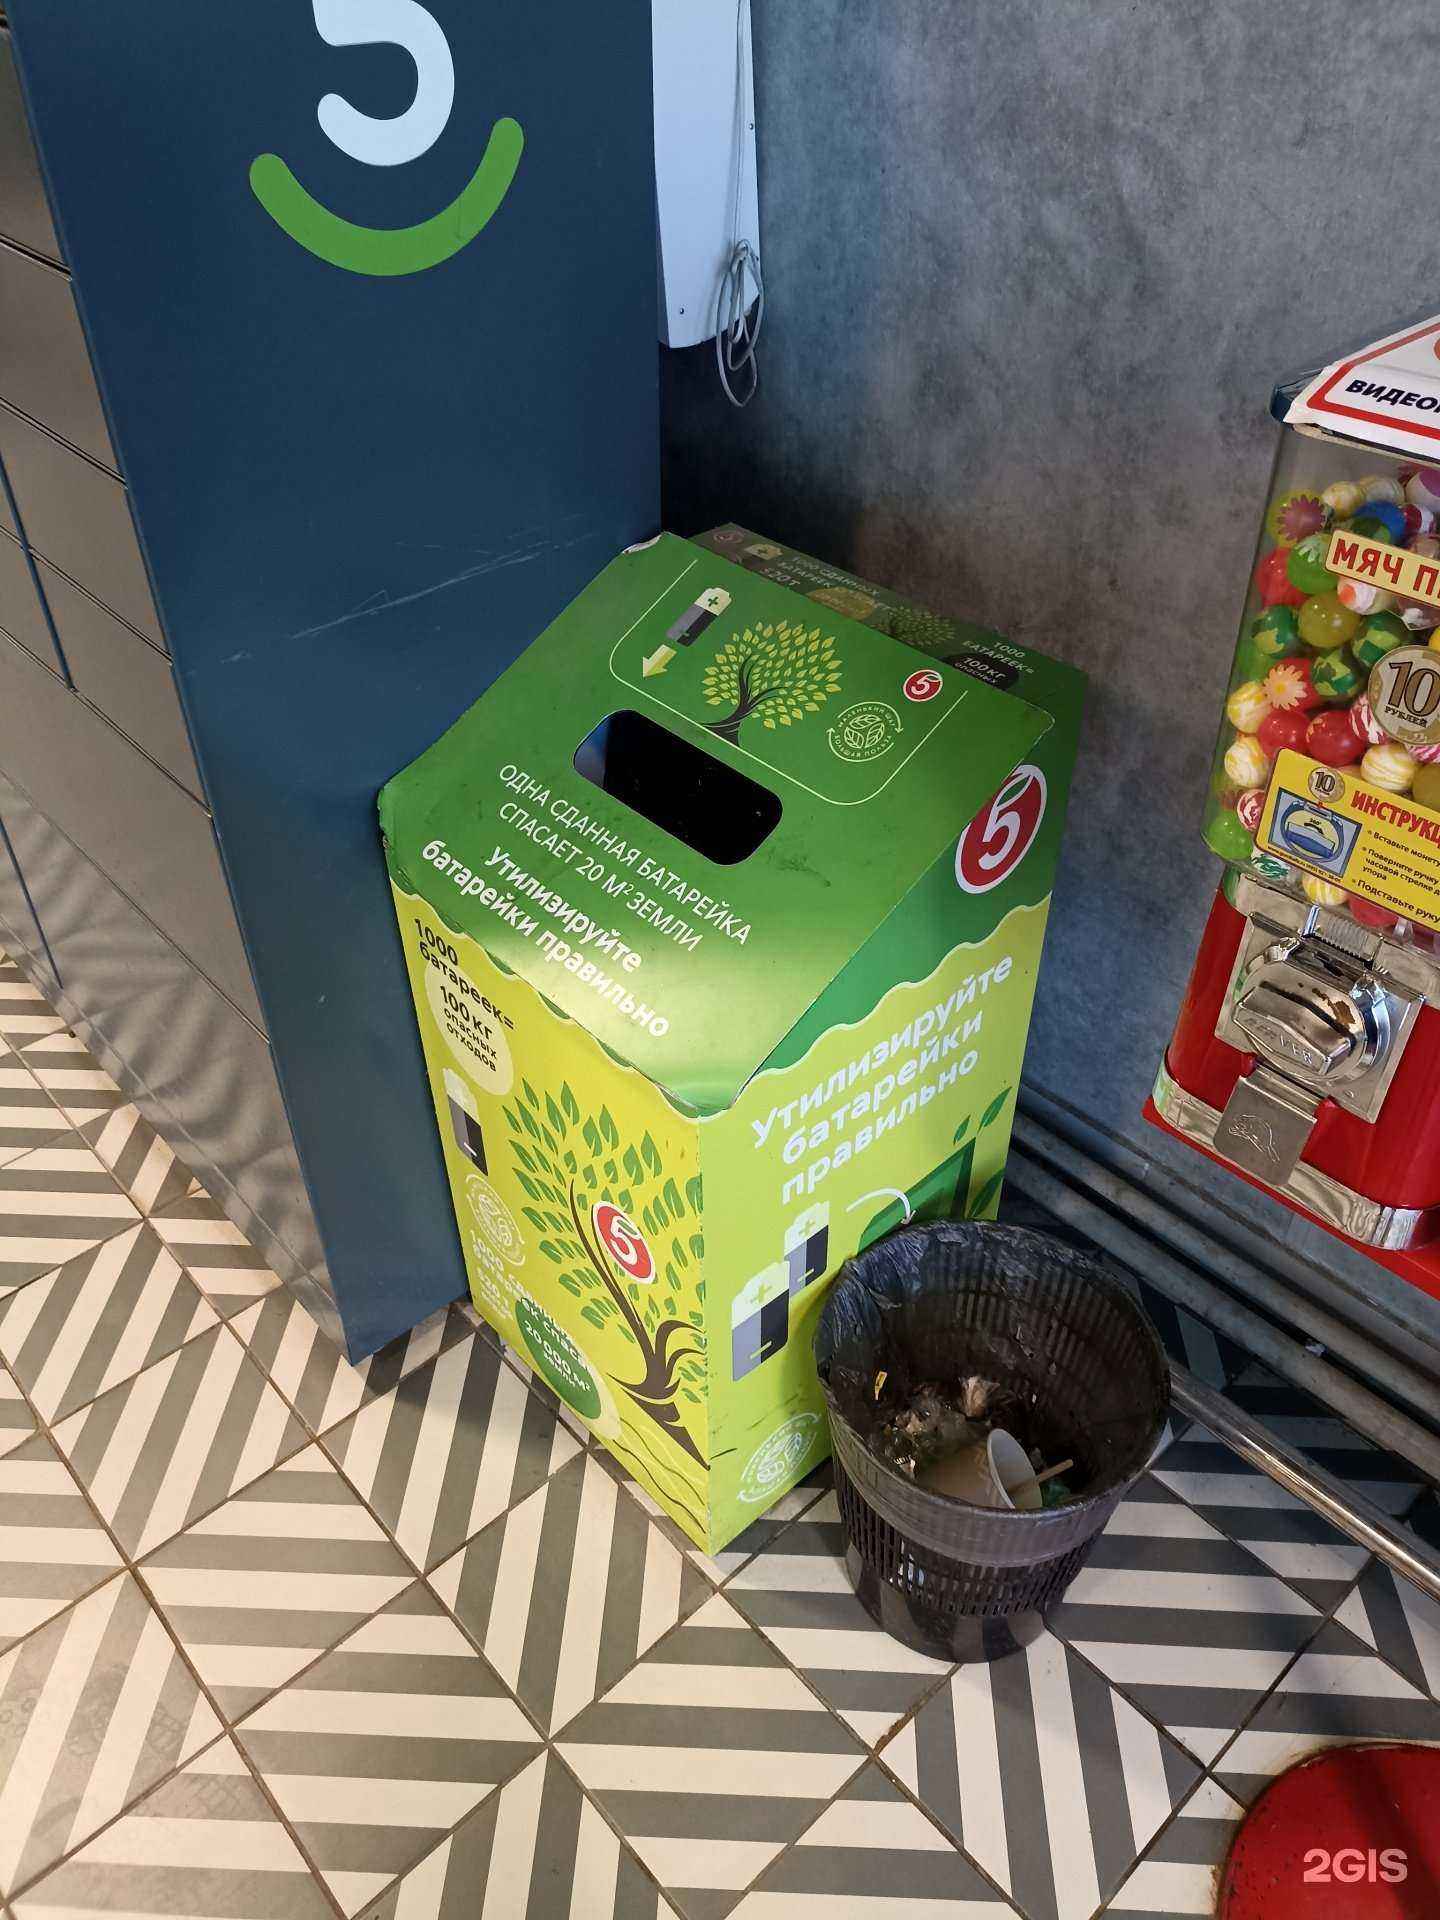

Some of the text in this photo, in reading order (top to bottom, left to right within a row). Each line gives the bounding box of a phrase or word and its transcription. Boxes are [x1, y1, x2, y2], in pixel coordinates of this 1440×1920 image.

[1345, 379, 1440, 414] ВИДЕО
[1332, 538, 1440, 599] МЯЧ П
[963, 657, 989, 671] 100
[993, 642, 1026, 658] 1000
[1389, 661, 1440, 717] 10
[1315, 771, 1335, 793] 10
[1350, 790, 1440, 849] ИНСТРУКЦ
[1373, 832, 1409, 853] Вставьте
[499, 764, 753, 946] ОДНА СДАННАЯ БАТАРЕЙКА
[499, 801, 583, 865] СПАСАЕТ
[575, 860, 601, 882] 20
[626, 895, 703, 952] ЗЕМЛИ
[1362, 866, 1387, 881] упора
[1365, 858, 1399, 877] часовой
[1400, 873, 1433, 893] стрелке
[1368, 848, 1413, 874] Поверните
[1413, 870, 1439, 886] ручку
[1357, 880, 1440, 924] Подставьте руку
[414, 918, 458, 966] 1000
[421, 839, 670, 1038] батарейки правильно
[440, 986, 494, 1041] 100 кг
[444, 1008, 498, 1060] опасных
[446, 1022, 498, 1072] отходов
[782, 1010, 983, 1166] батарейки
[781, 1050, 979, 1204] правильно
[524, 1320, 542, 1345] 20
[543, 1339, 572, 1375] 000
